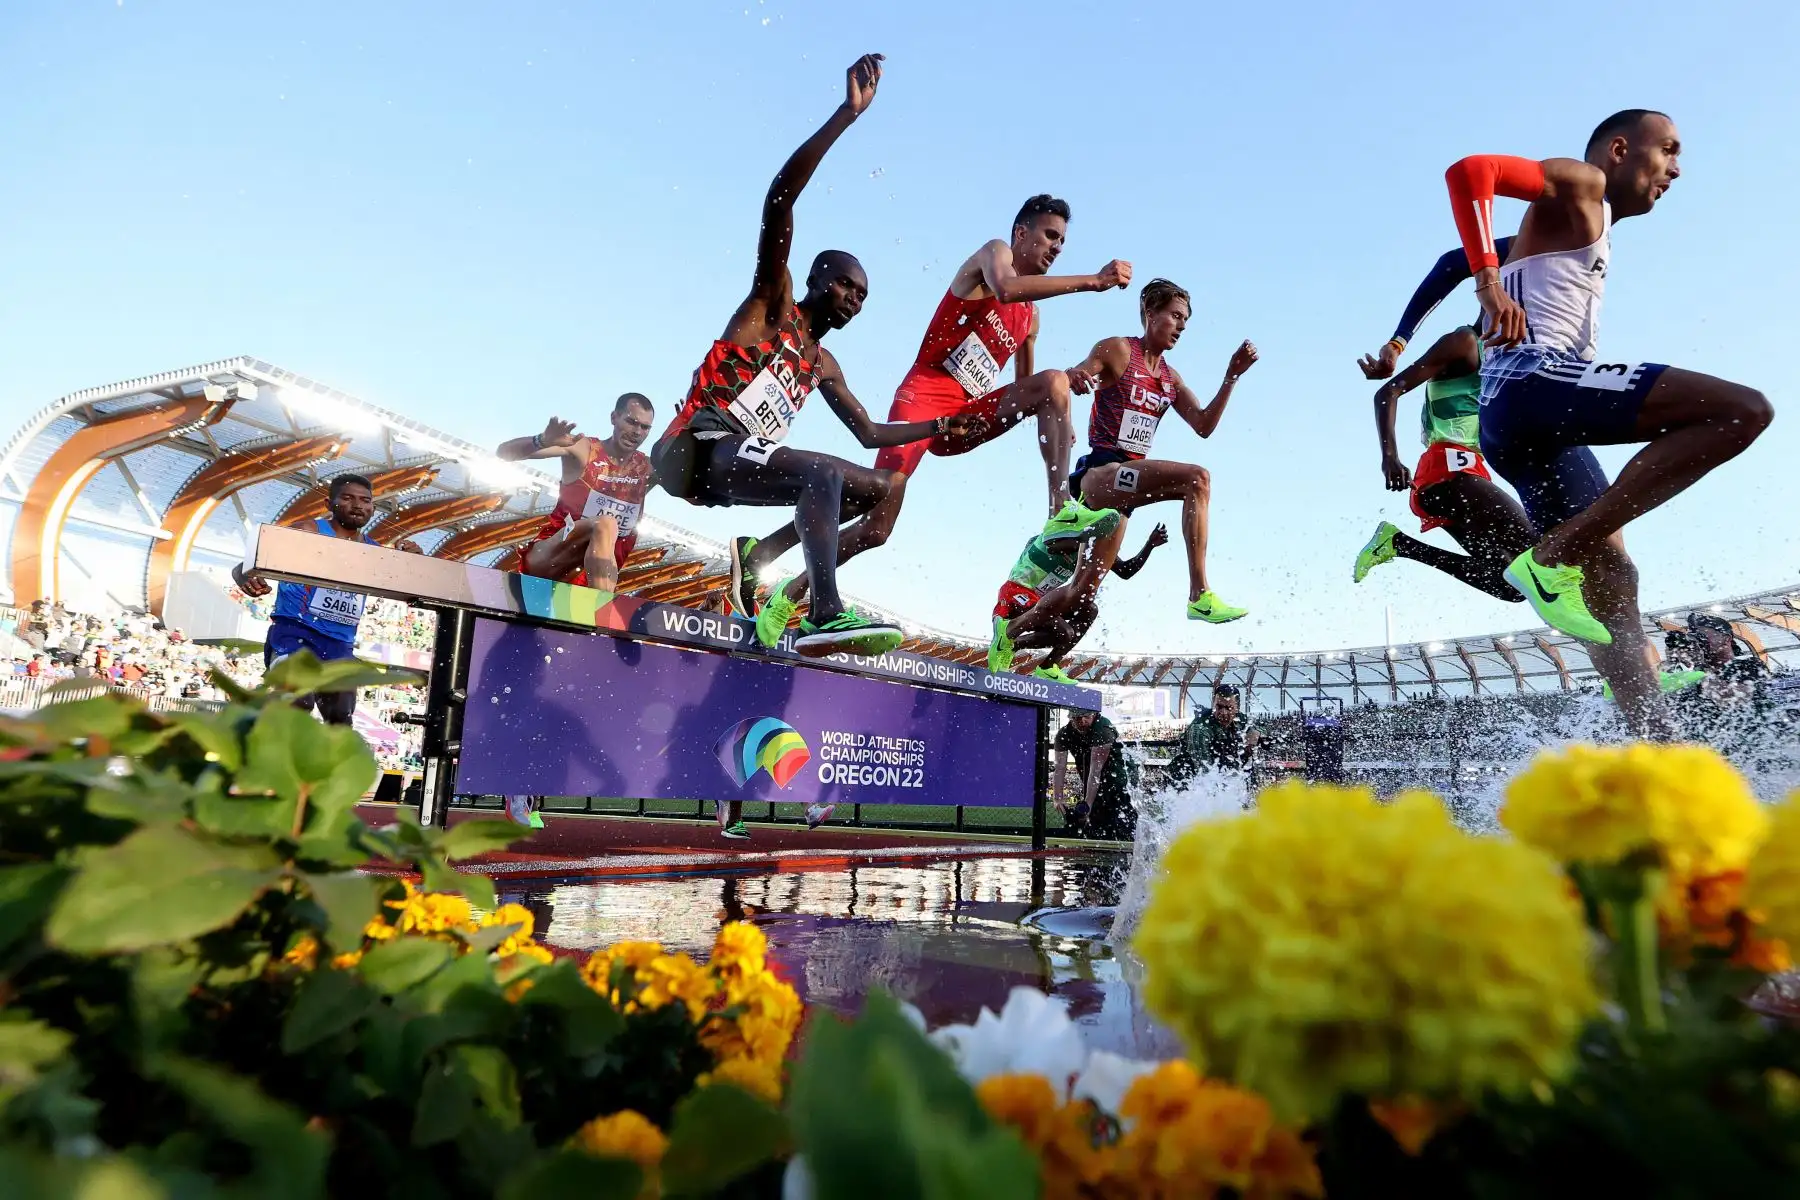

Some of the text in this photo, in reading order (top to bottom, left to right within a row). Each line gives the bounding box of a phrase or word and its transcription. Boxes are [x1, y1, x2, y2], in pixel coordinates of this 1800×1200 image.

[955, 348, 968, 365] EL
[977, 350, 997, 379] TDK
[1594, 363, 1628, 376] 3
[756, 400, 781, 435] BETT
[774, 391, 795, 427] TDK
[746, 438, 777, 454] 14
[1457, 451, 1468, 467] 5
[1118, 471, 1135, 488] 15
[607, 500, 636, 515] TDK
[323, 597, 356, 615] SABLE
[662, 610, 1049, 699] WORLD CHAMPIONSHIPS OREGON22
[821, 730, 925, 753] WORLD ATHLETICS
[820, 745, 924, 767] CHAMPIONSHIPS
[818, 762, 924, 788] OREGON22
